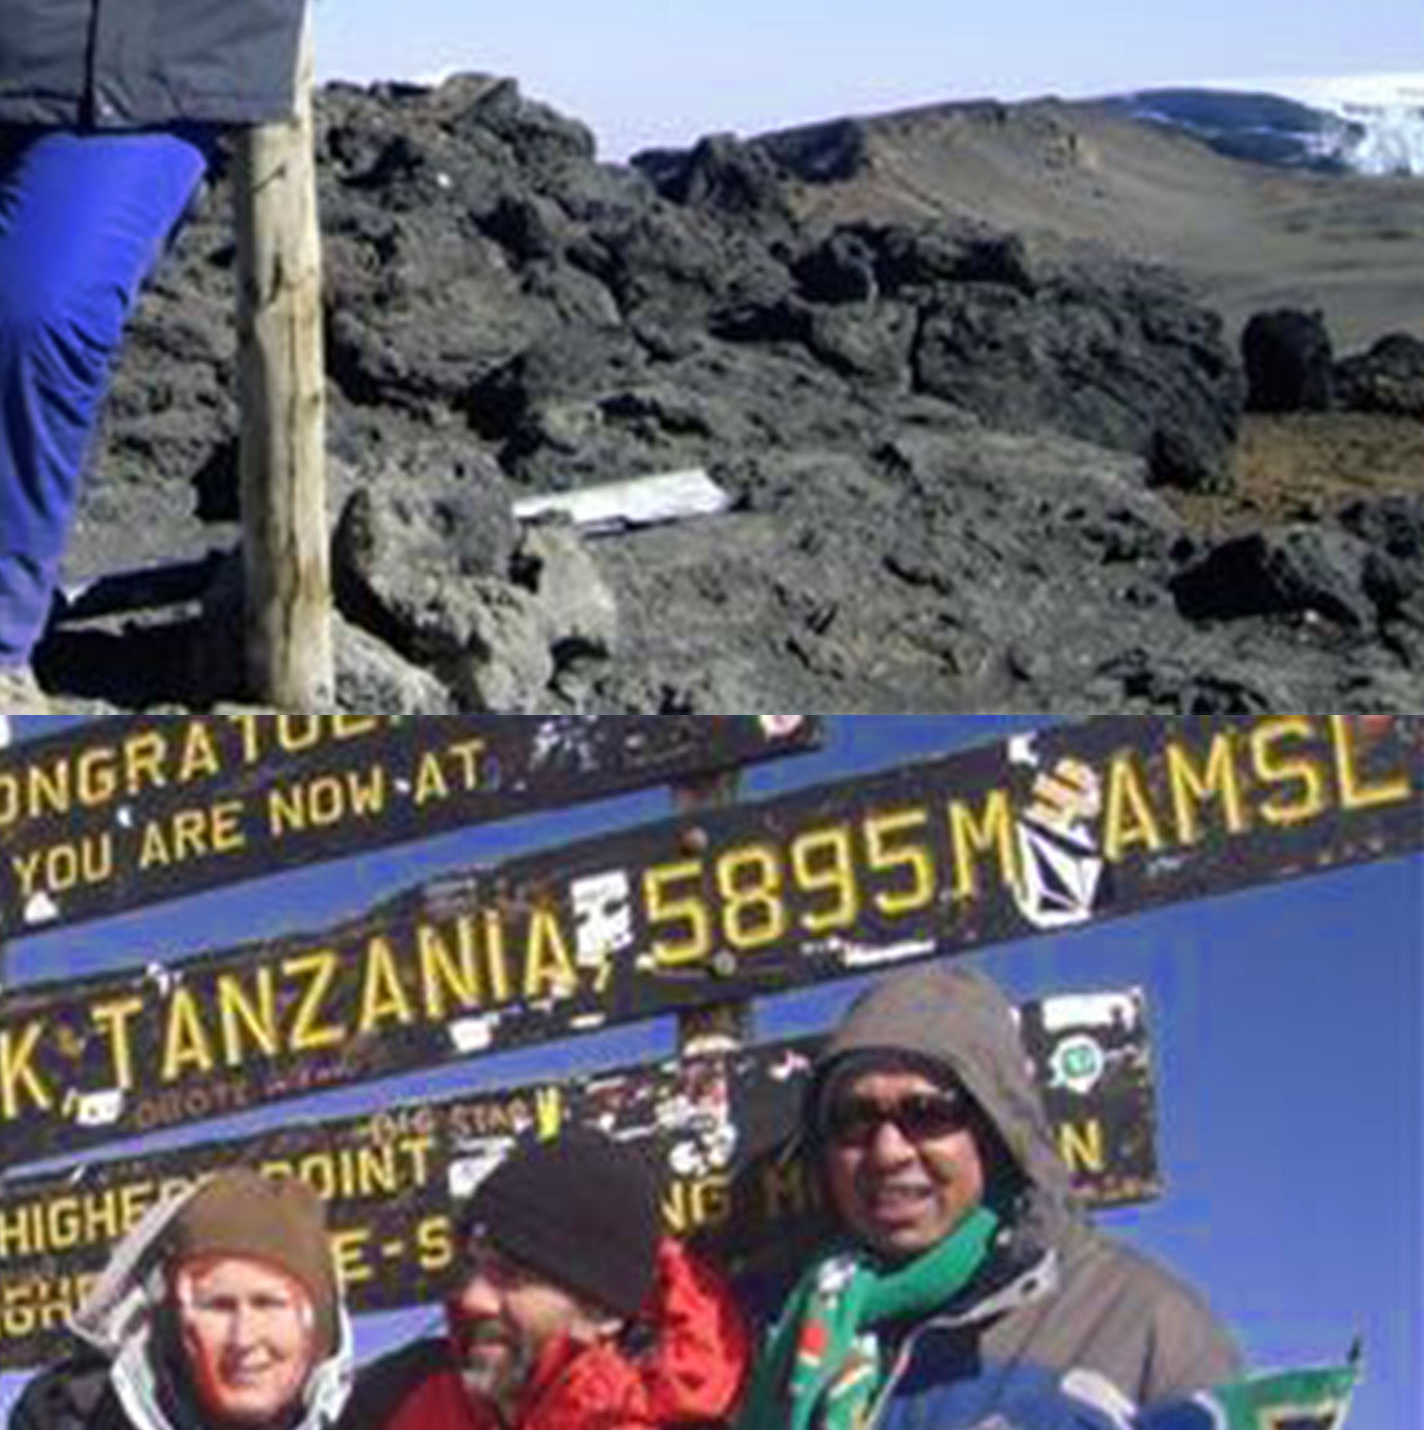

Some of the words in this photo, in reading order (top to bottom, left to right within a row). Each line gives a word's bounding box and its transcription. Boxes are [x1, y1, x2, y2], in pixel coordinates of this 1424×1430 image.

[12, 833, 112, 895] YOU
[139, 801, 246, 869] ARE
[270, 767, 385, 833] NOW
[414, 739, 487, 805] AT
[642, 785, 1025, 965] 5895M
